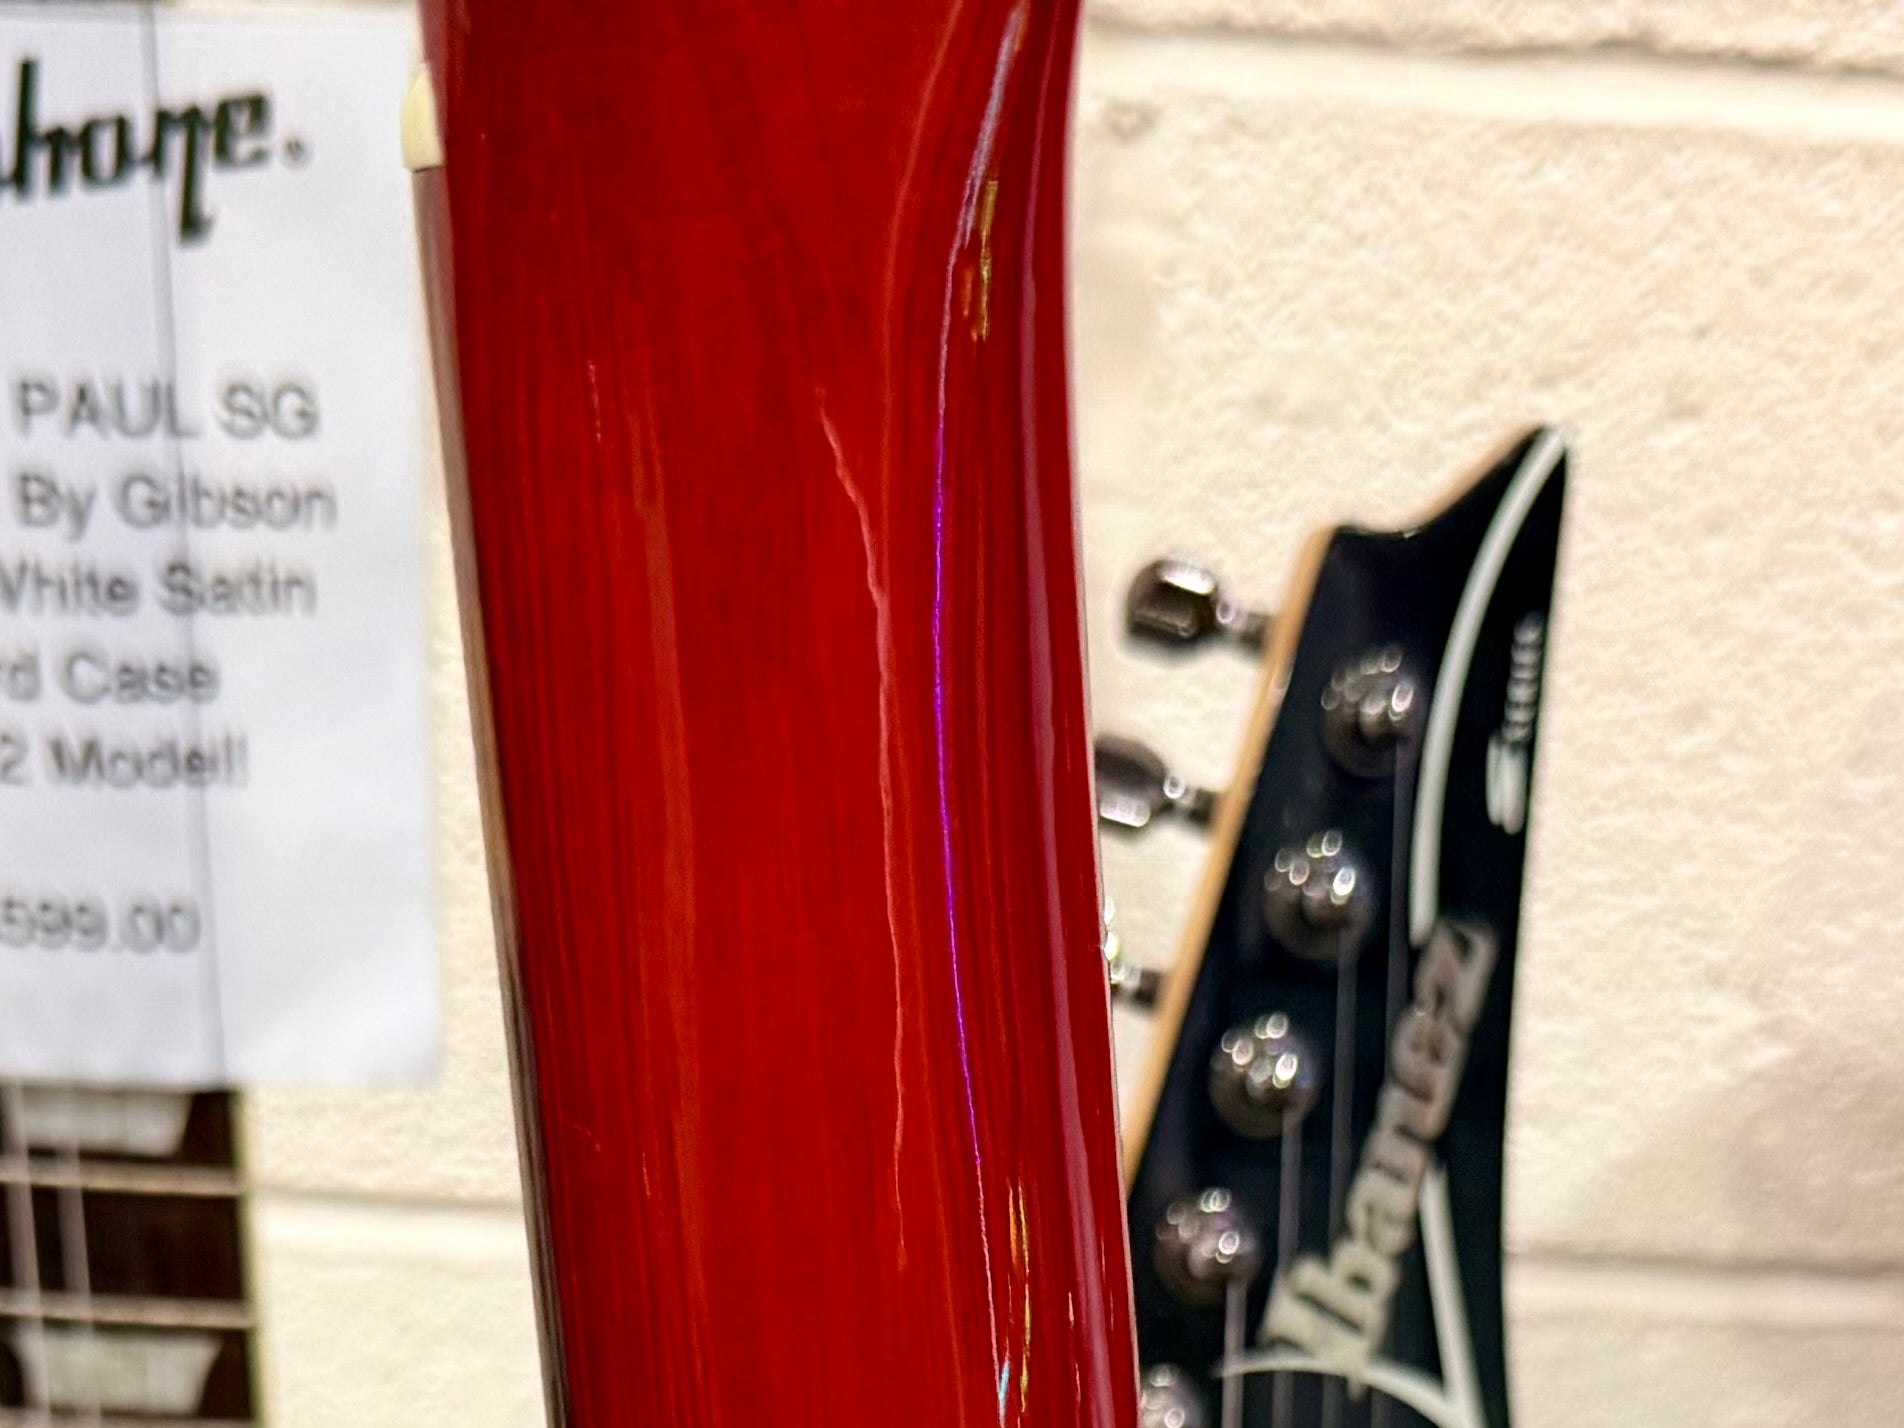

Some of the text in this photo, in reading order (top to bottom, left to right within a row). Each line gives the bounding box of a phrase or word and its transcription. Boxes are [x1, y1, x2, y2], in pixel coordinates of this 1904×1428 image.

[11, 374, 204, 440] PAUL
[217, 378, 322, 441] SG
[13, 470, 98, 540] By
[117, 471, 340, 530] Gibson
[154, 558, 318, 616] Satin
[62, 647, 222, 705] Case
[1260, 920, 1498, 1396] Ibanez
